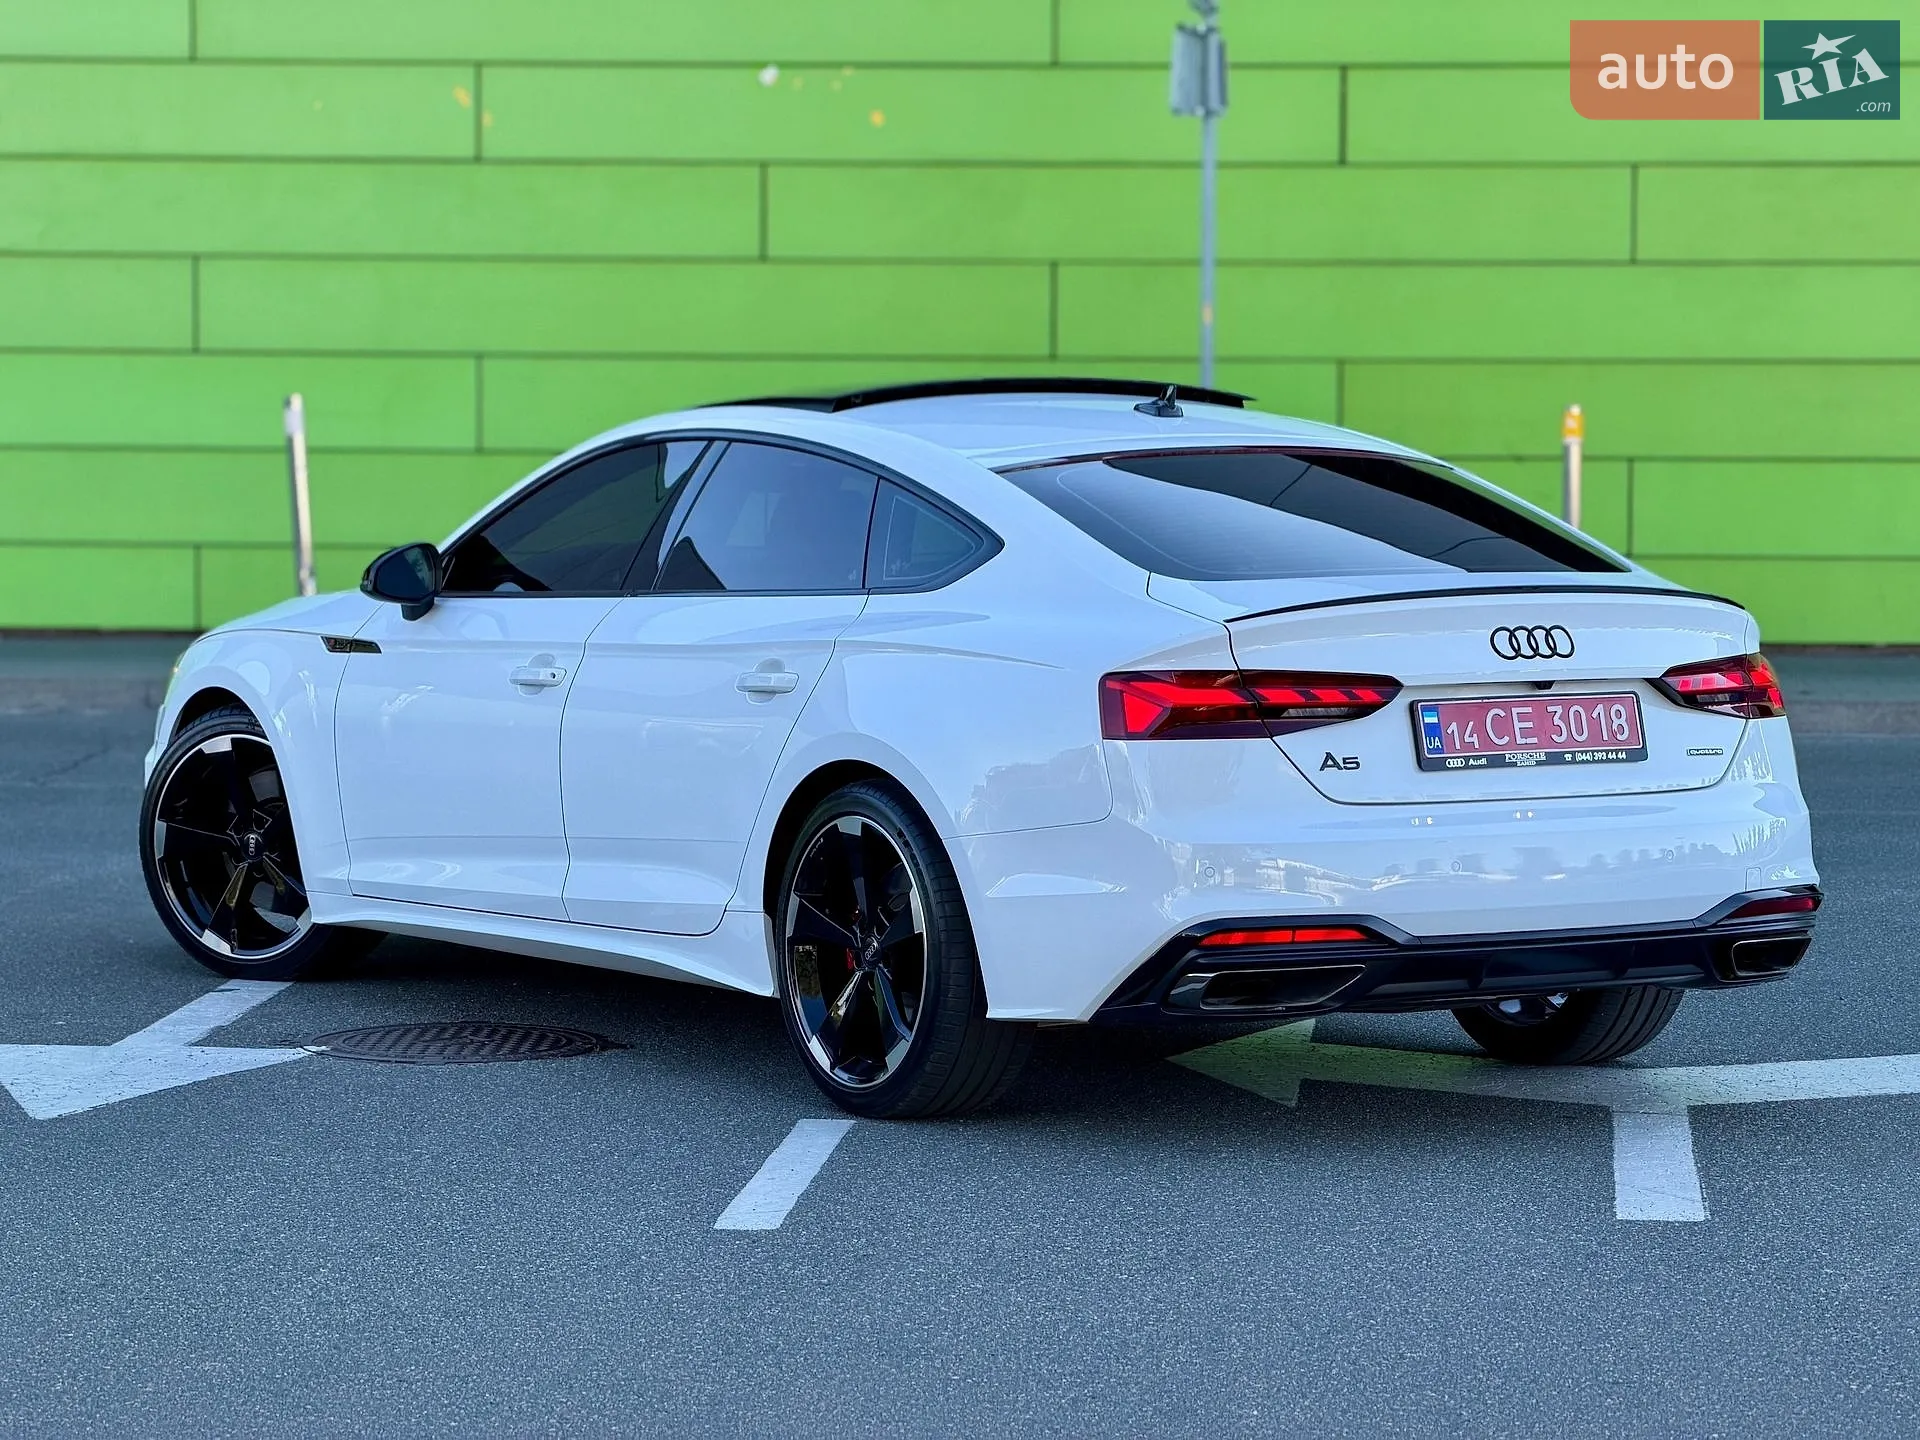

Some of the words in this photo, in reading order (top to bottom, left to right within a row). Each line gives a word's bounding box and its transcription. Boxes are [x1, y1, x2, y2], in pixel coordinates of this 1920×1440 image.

[1446, 721, 1480, 750] 14
[1484, 707, 1538, 746] CE
[1547, 704, 1630, 743] 3018
[1426, 737, 1442, 749] UA
[1319, 751, 1361, 771] A5
[1505, 752, 1546, 761] PORSCHE
[1593, 752, 1606, 760] 393
[1468, 758, 1487, 766] Audi
